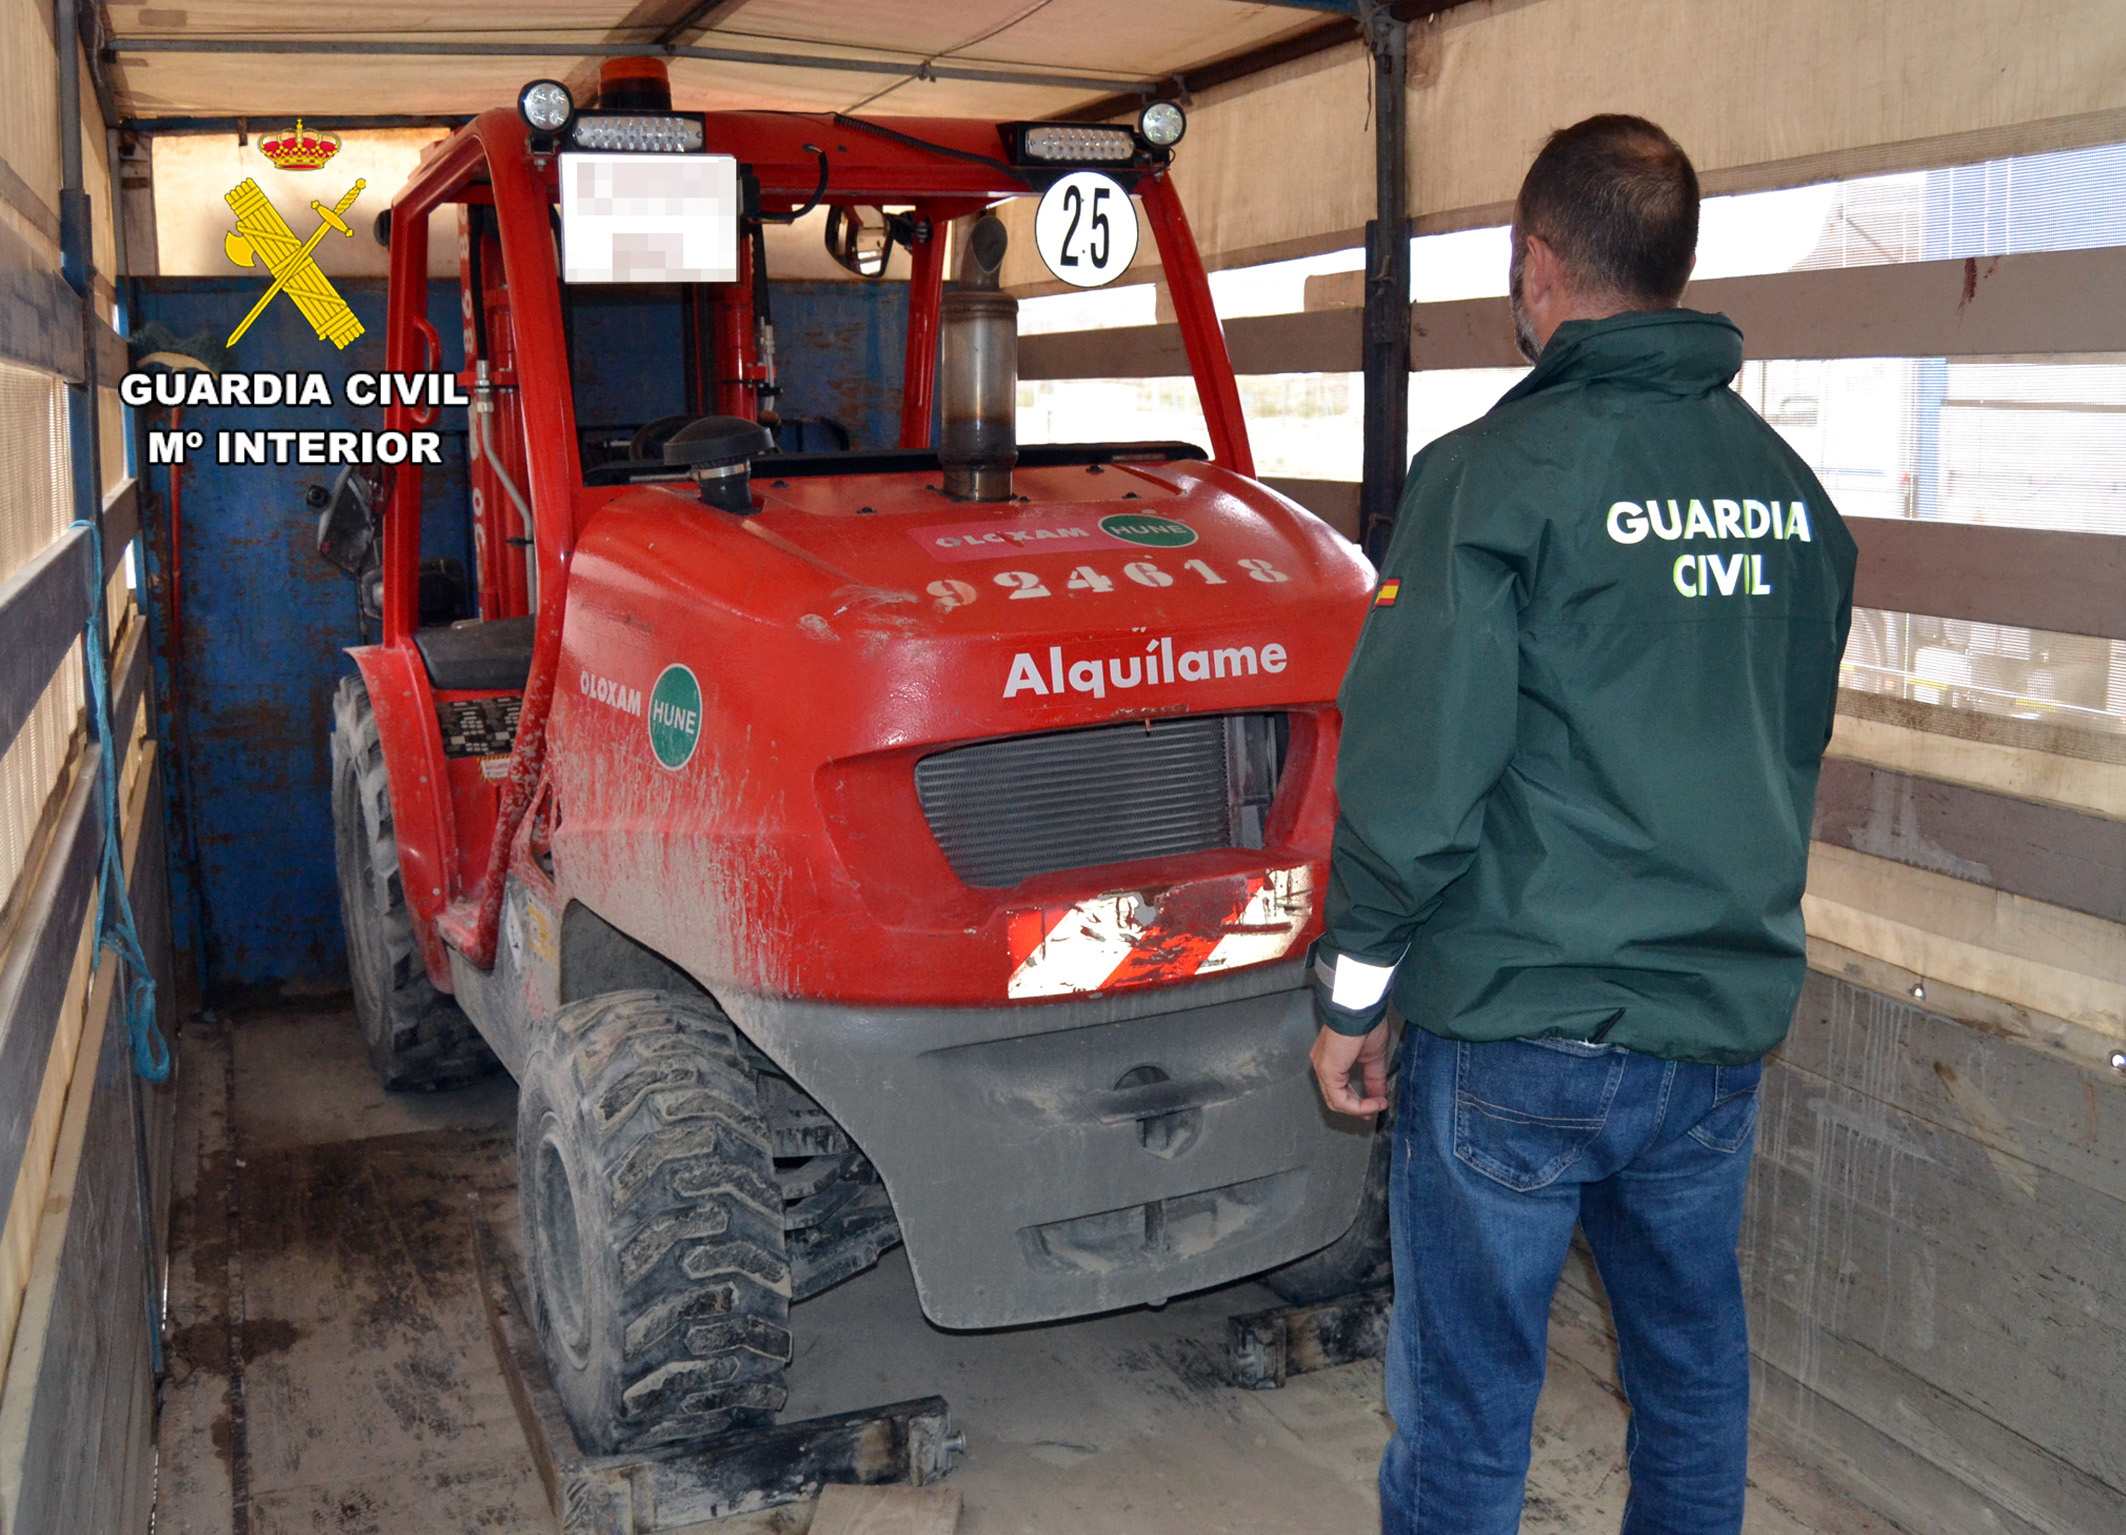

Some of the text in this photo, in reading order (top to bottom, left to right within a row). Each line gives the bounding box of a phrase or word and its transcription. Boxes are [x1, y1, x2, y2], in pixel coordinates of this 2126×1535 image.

[1060, 184, 1110, 269] 25
[1111, 523, 1187, 536] HUNE
[1606, 498, 1811, 544] GUARDIA
[926, 558, 1290, 608] 924618
[1673, 553, 1771, 598] CIVIL
[1002, 636, 1288, 699] Alquílame
[652, 699, 697, 735] HUNE
